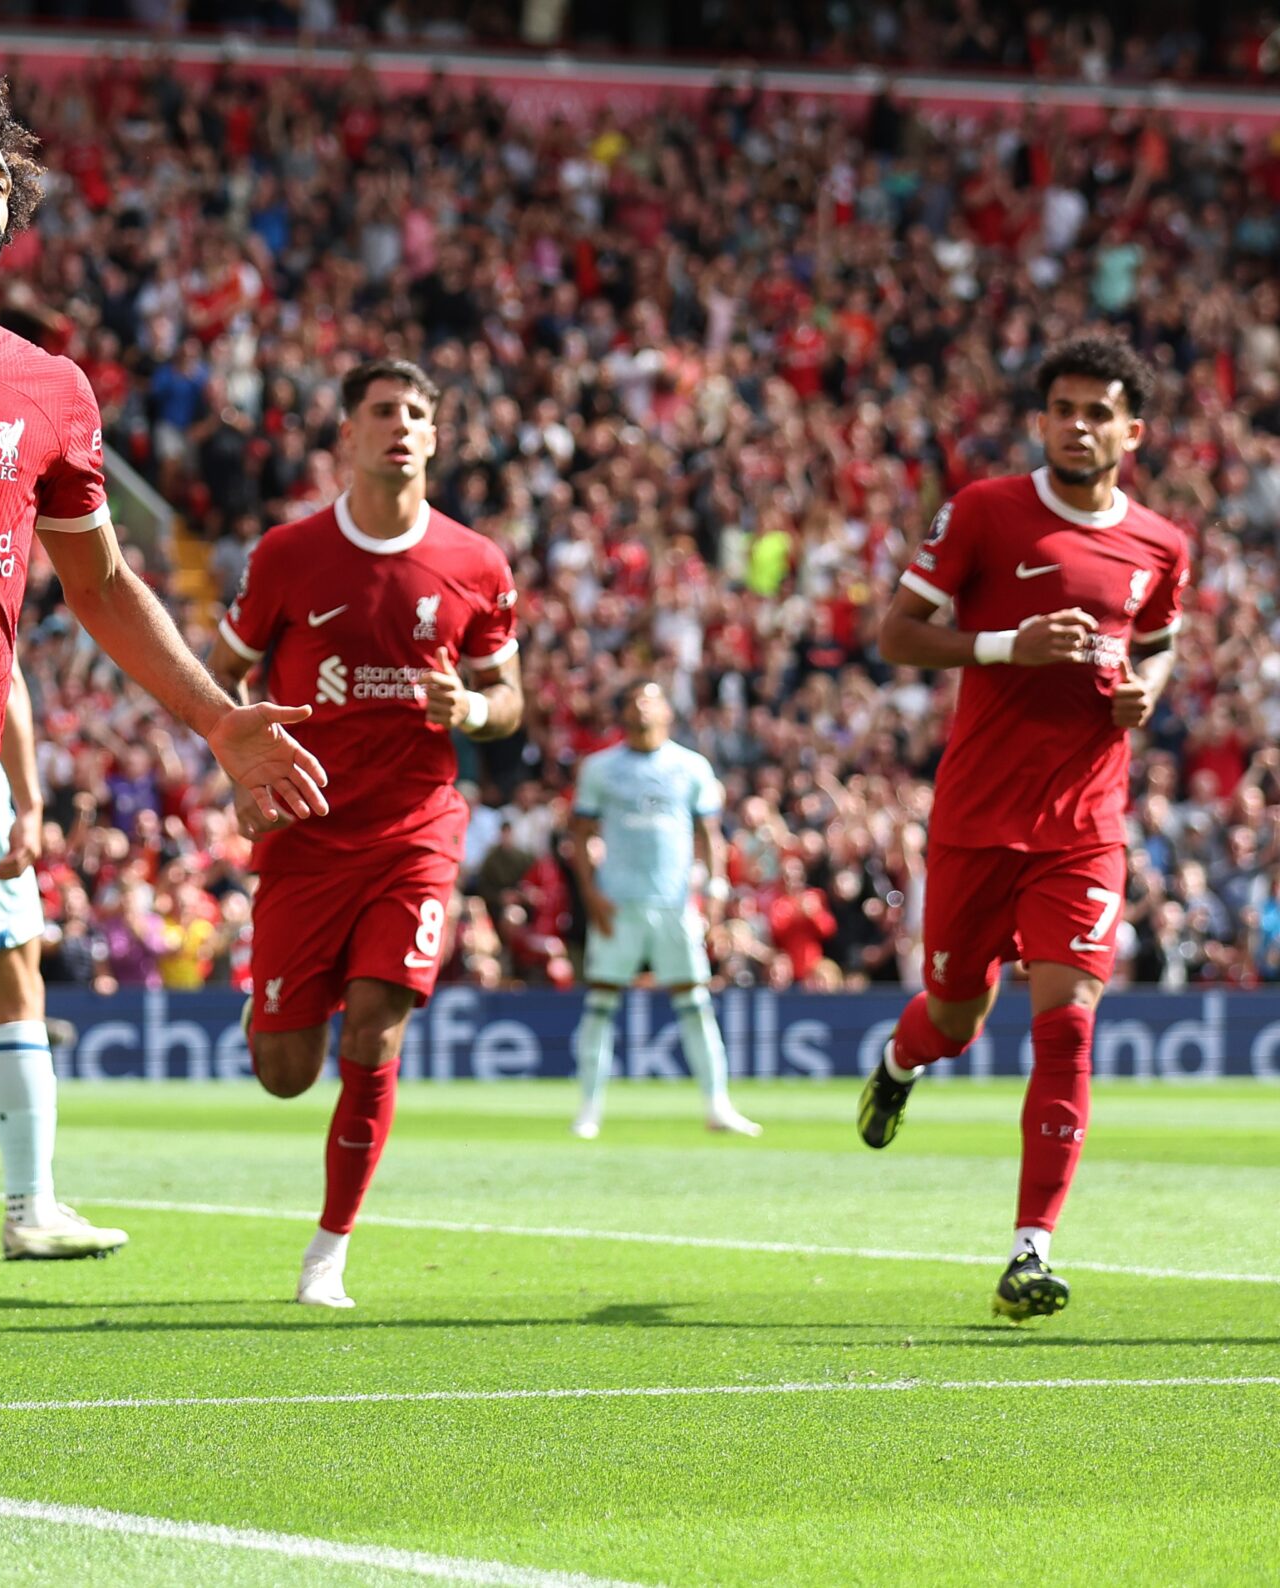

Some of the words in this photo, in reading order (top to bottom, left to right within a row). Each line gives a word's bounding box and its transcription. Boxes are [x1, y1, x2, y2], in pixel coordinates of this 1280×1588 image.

[416, 898, 444, 957] 8
[1086, 887, 1120, 942] 7
[401, 988, 541, 1081] ife
